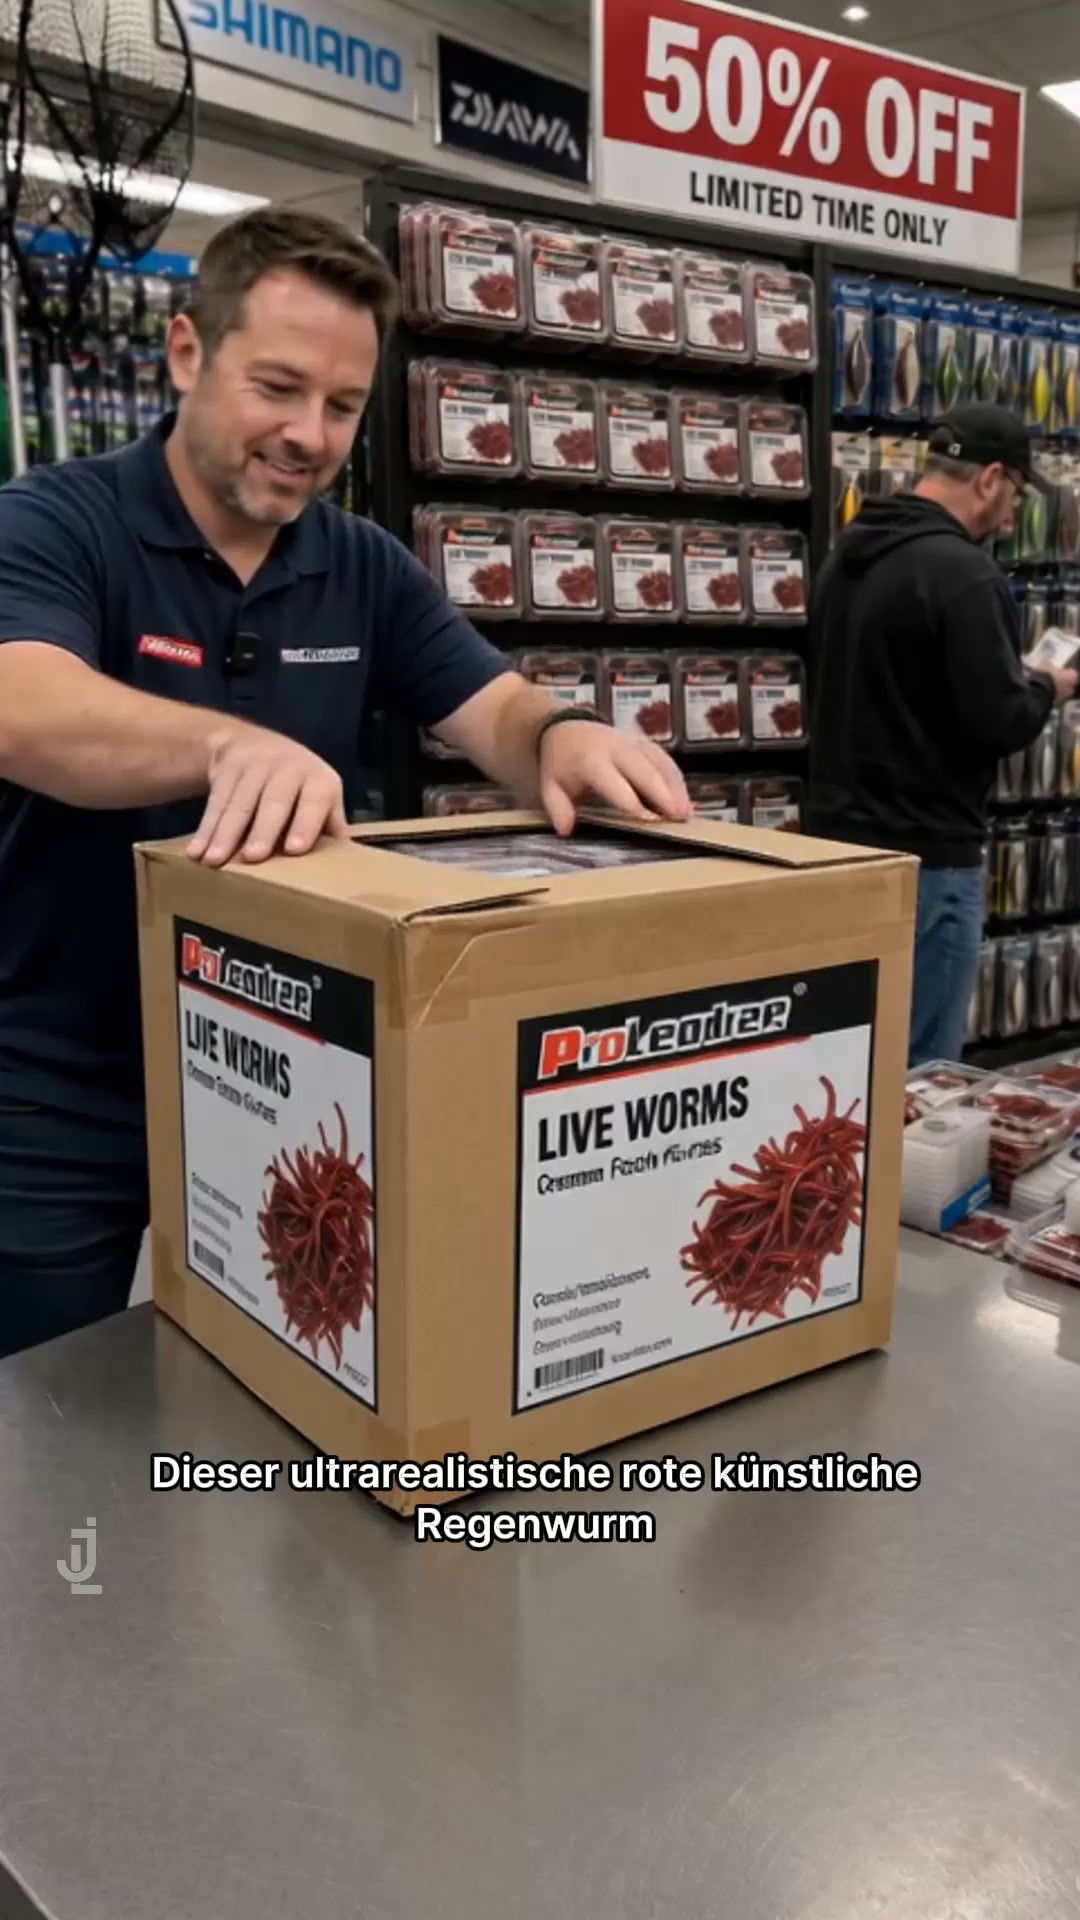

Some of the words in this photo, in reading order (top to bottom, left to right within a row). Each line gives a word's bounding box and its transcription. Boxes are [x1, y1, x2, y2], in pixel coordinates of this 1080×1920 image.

[189, 0, 402, 92] SHIMANO
[643, 16, 842, 165] 50%
[865, 76, 994, 193] OFF
[690, 171, 803, 221] LIMITED
[812, 194, 875, 235] TIME
[884, 208, 948, 247] ONLY
[537, 1105, 615, 1163] LIVE
[624, 1075, 750, 1142] WORMS
